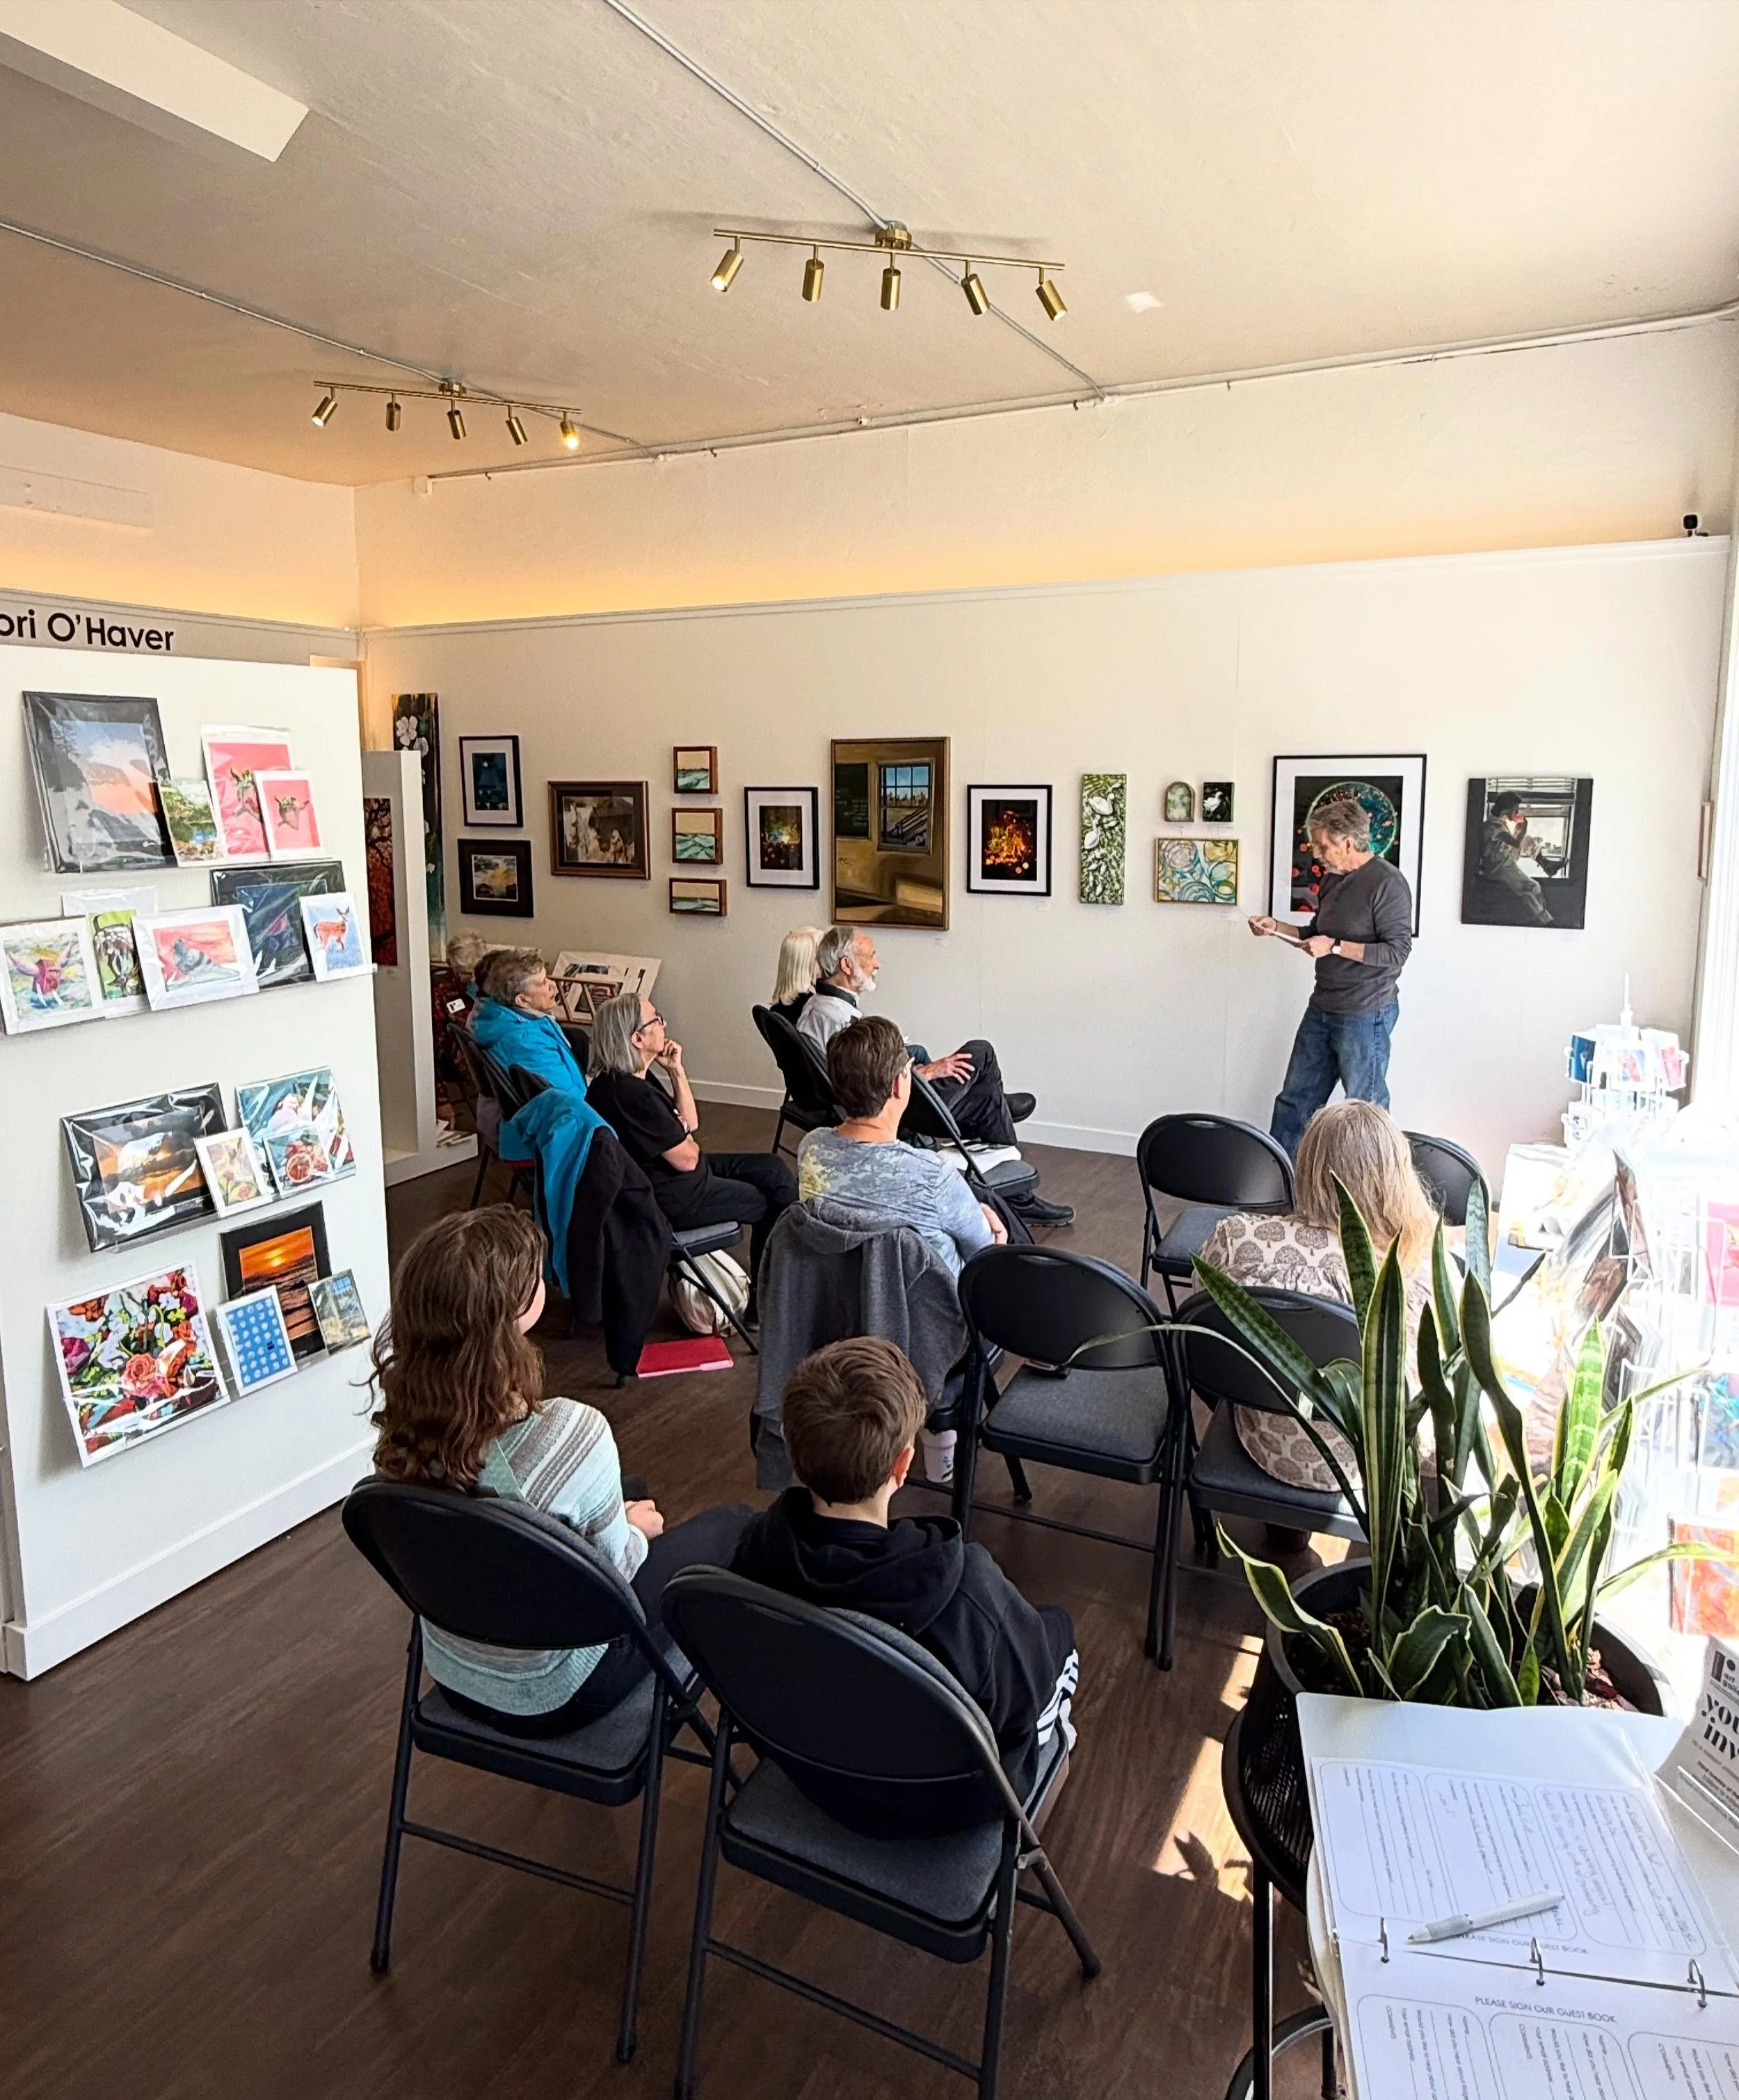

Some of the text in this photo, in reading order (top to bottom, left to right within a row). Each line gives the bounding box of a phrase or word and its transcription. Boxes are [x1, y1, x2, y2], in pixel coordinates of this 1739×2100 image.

[47, 612, 174, 651] O'Haver
[1539, 1943, 1560, 1952] UEST
[1475, 1996, 1619, 2023] PLEASE SIGN OUR GUEST BOOK
